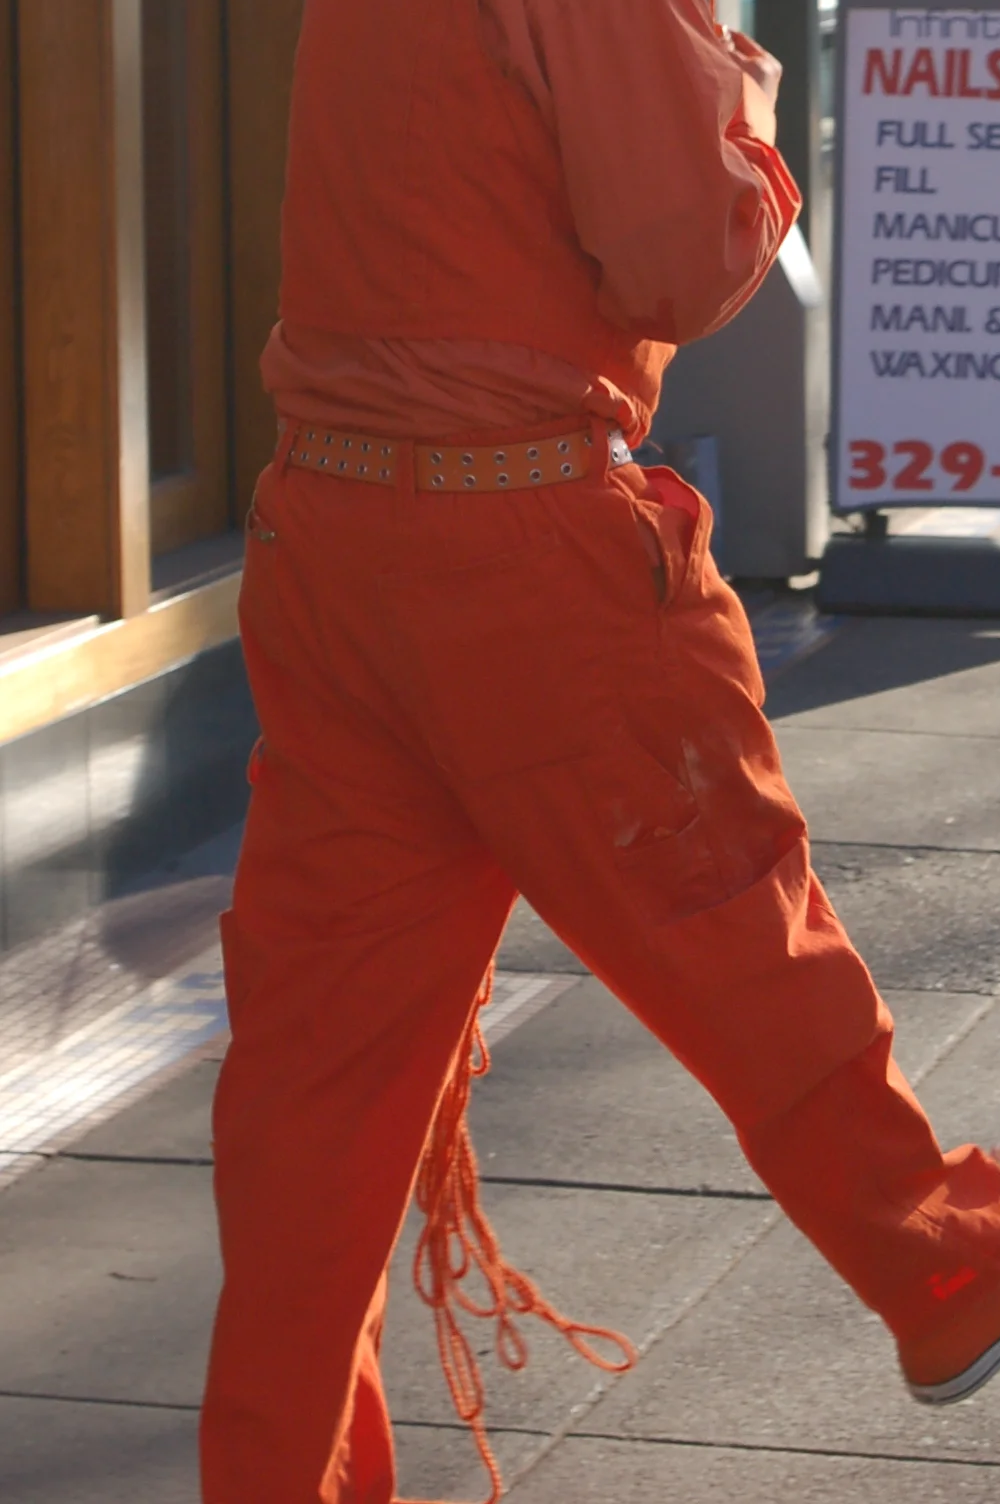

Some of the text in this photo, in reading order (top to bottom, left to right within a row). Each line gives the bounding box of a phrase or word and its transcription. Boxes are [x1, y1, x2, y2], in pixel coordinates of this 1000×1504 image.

[876, 120, 955, 148] FULL
[874, 166, 937, 195] FILL
[869, 304, 972, 333] MANI.
